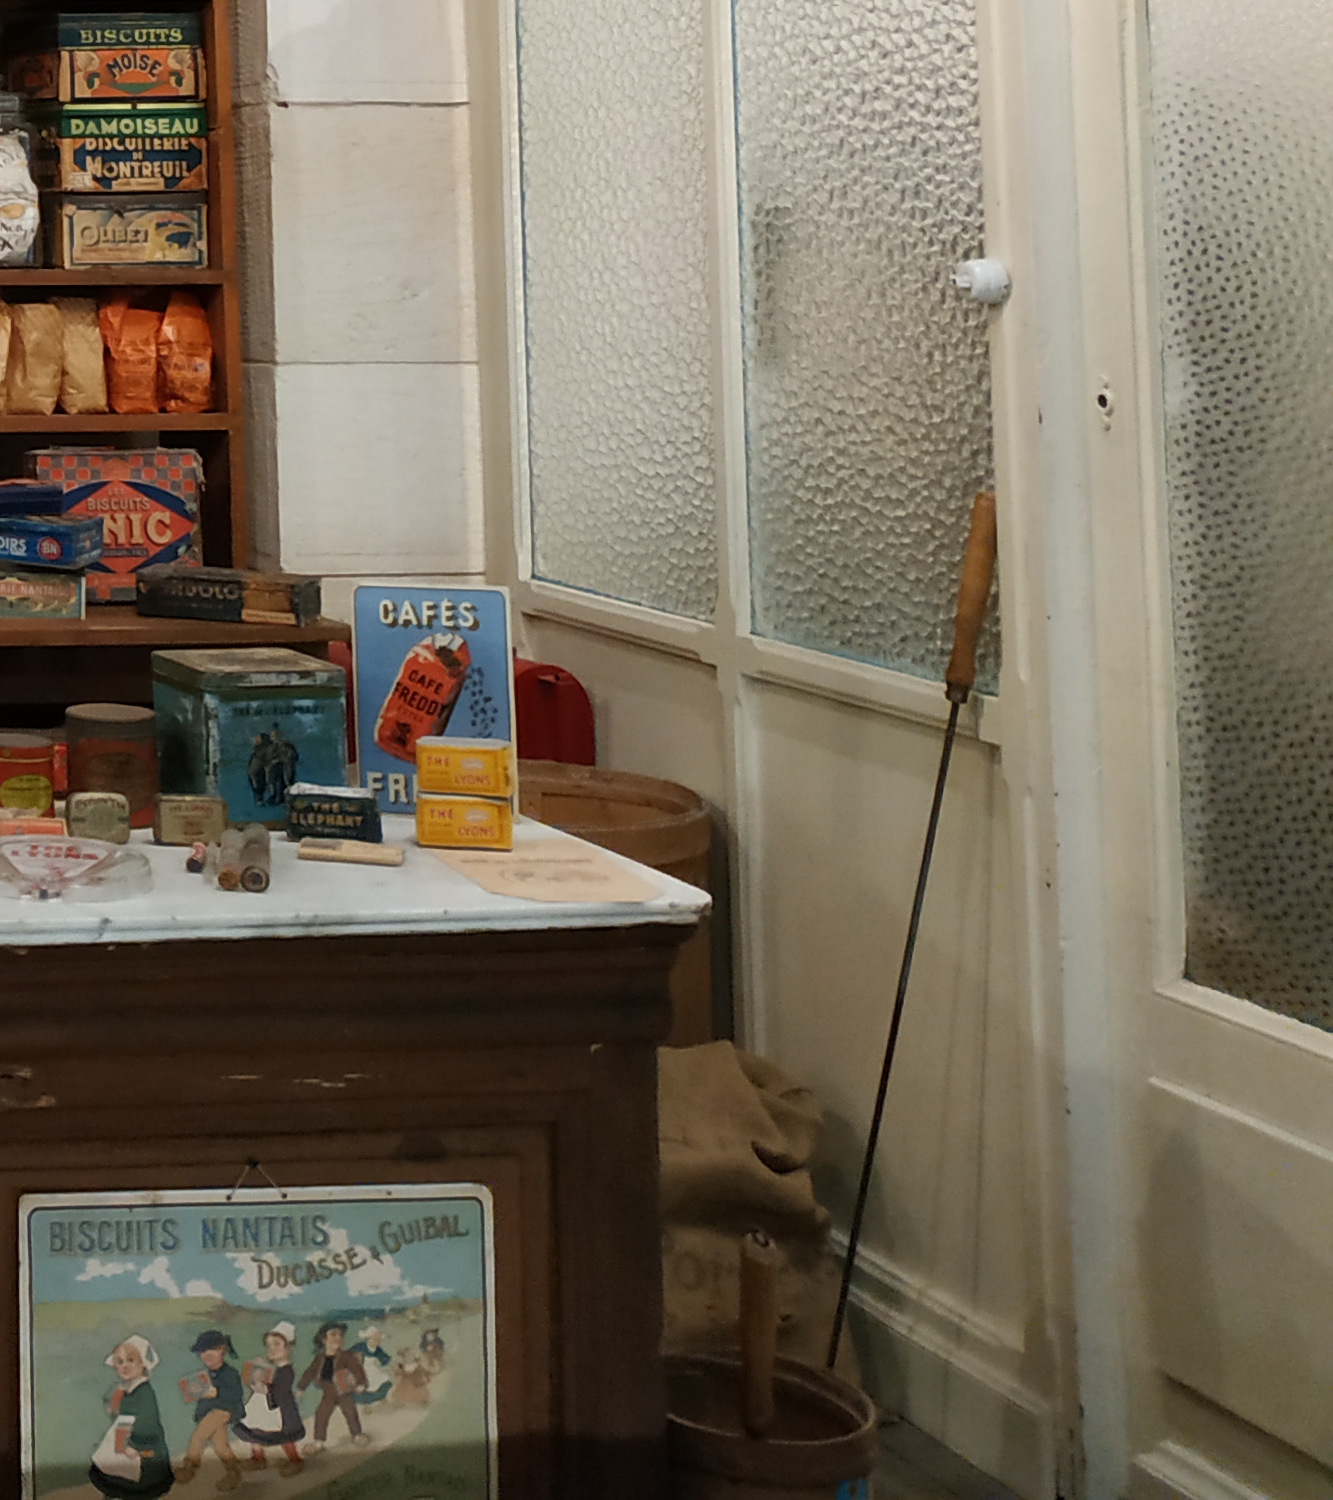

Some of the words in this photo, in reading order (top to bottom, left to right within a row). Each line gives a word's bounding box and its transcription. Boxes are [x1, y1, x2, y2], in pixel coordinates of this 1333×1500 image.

[78, 27, 184, 45] BISCUITS
[105, 49, 163, 78] MOÏSE
[69, 117, 200, 136] DAMOISEAU
[85, 155, 191, 178] MONTREUIL
[80, 225, 151, 247] OLIBET
[86, 497, 152, 511] BISCUITS
[41, 542, 58, 554] BN
[378, 598, 479, 631] CAFÉS
[393, 680, 449, 718] FREDDY
[48, 1217, 181, 1255] BISCUITS
[200, 1213, 331, 1252] NANTAIS
[250, 1246, 367, 1291] DUCASSE
[377, 1213, 470, 1256] GUIBAL
